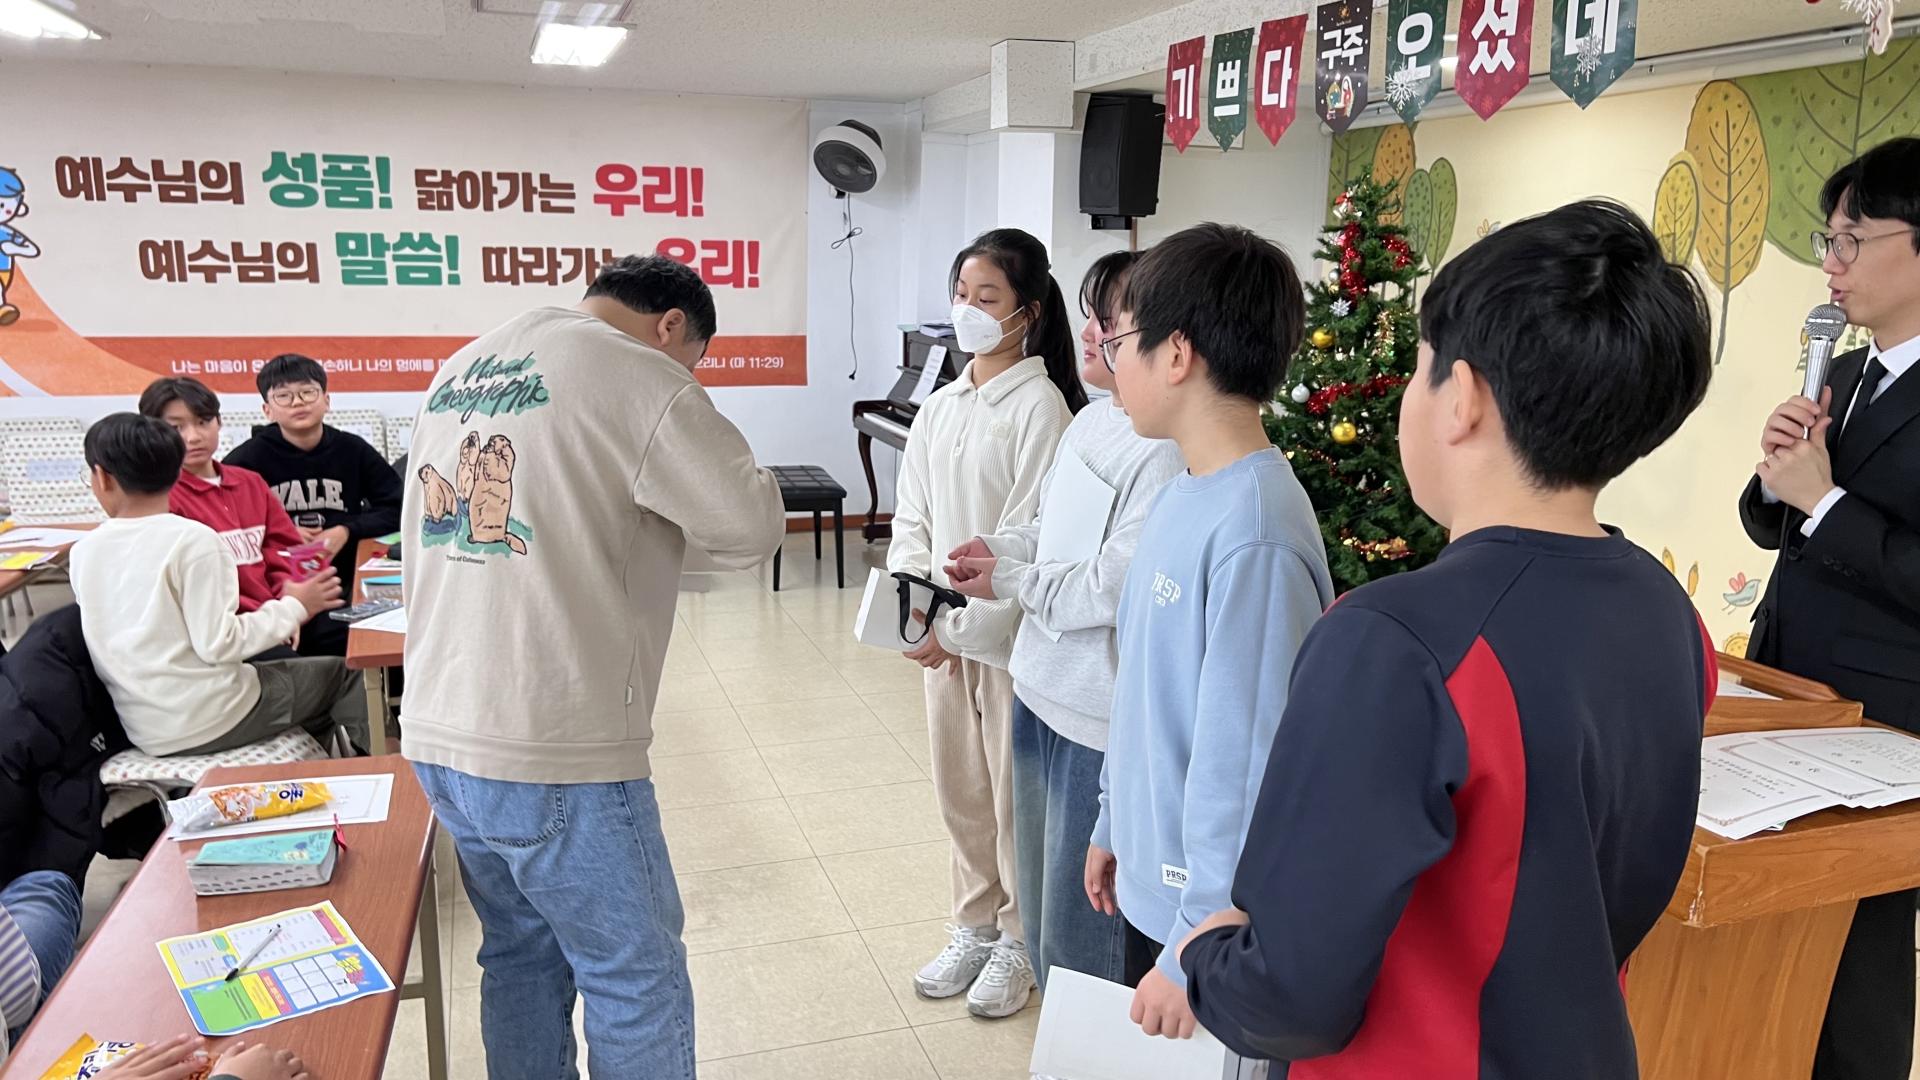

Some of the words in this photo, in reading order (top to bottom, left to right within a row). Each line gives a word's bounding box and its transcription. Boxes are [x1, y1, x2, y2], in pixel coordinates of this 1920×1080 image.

[1321, 24, 1364, 71] 구주
[55, 155, 244, 204] 예수님의
[262, 151, 391, 210] 성품!
[413, 168, 576, 215] 닮아가는
[593, 162, 704, 218] 우리!
[139, 239, 320, 285] 예수님의
[335, 231, 461, 286] 말씀!
[171, 359, 202, 374] 나는
[366, 358, 392, 373] 나의
[748, 356, 784, 369] 11:29)
[271, 478, 345, 511] YALE
